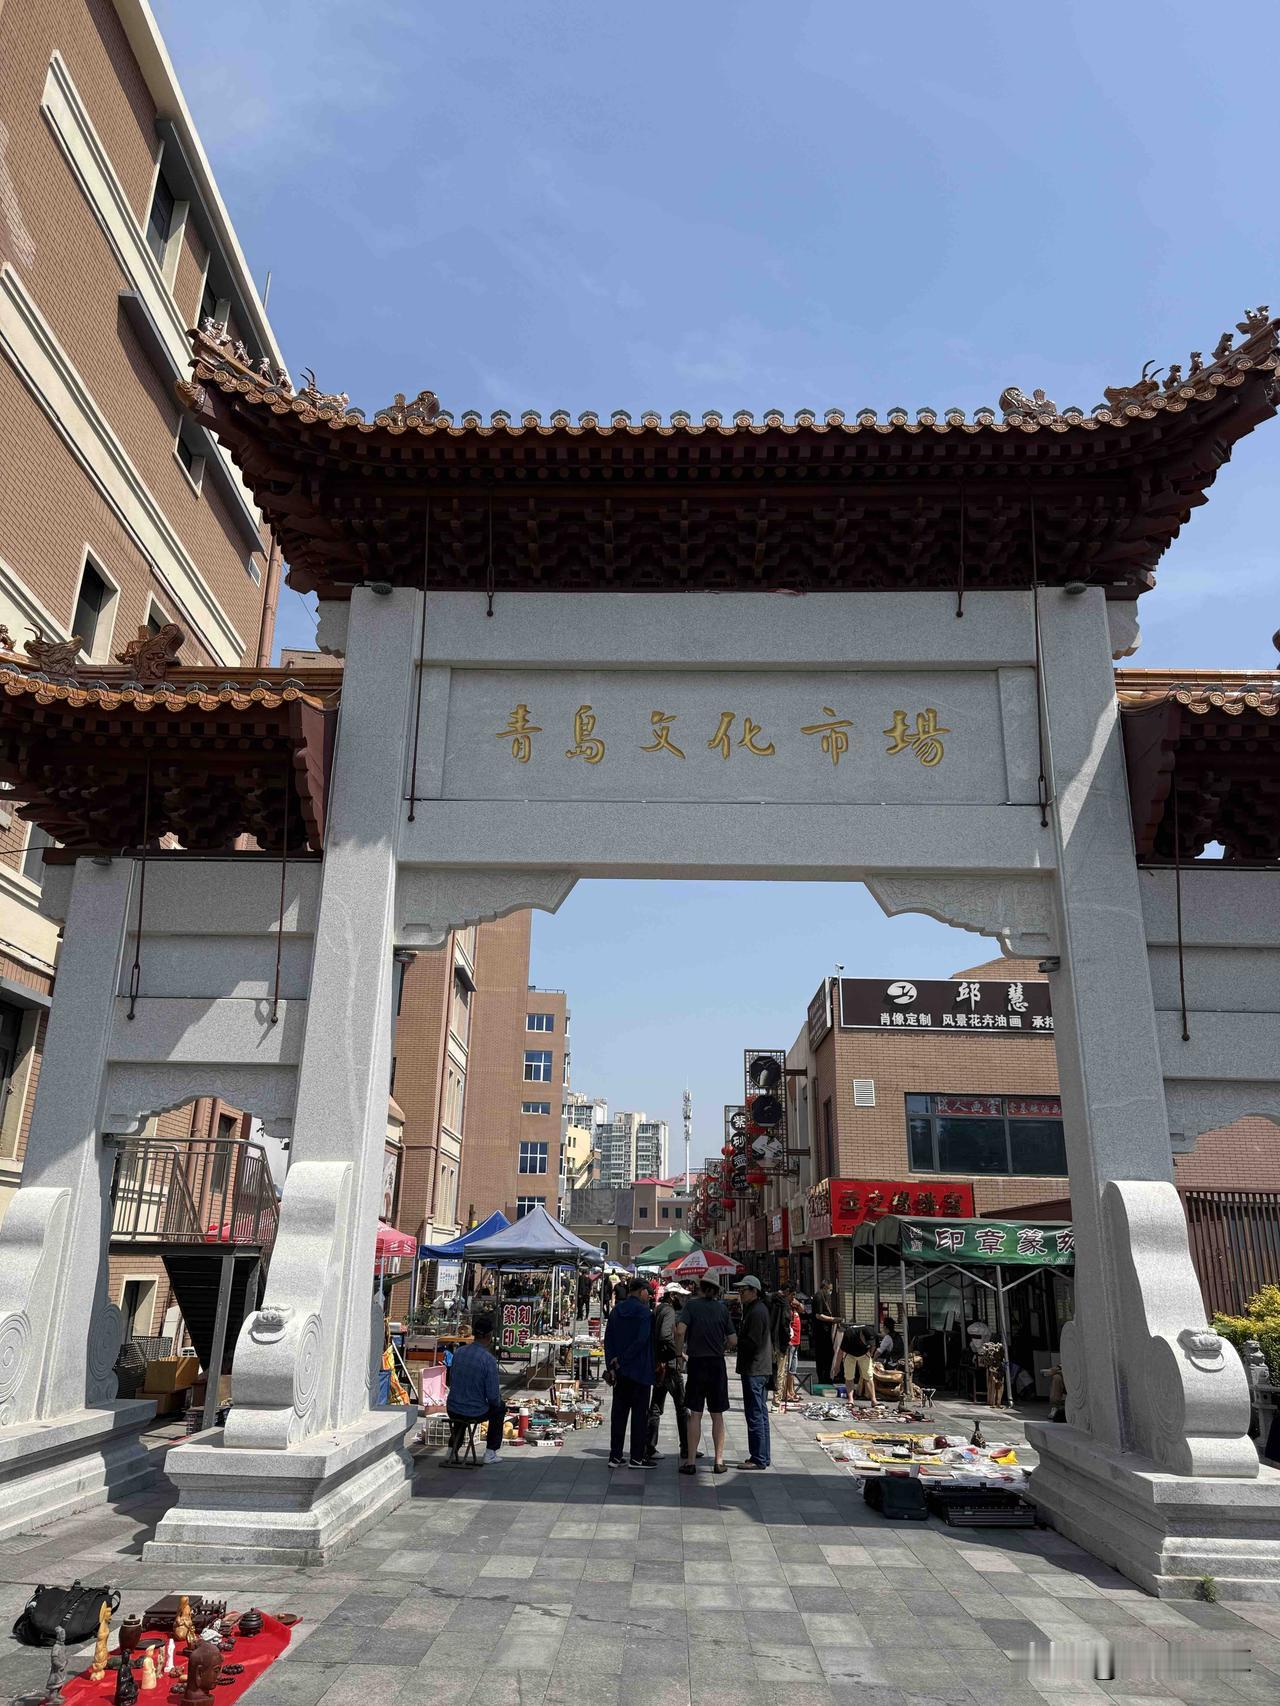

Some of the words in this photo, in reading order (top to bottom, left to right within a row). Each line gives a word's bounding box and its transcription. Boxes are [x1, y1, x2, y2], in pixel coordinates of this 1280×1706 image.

[496, 704, 951, 767] 青島文化市場
[880, 1013, 932, 1027] 肖像定制
[942, 1014, 1022, 1028] 风景花卉油画
[503, 1304, 531, 1326] 篆刻
[502, 1327, 530, 1349] 印章
